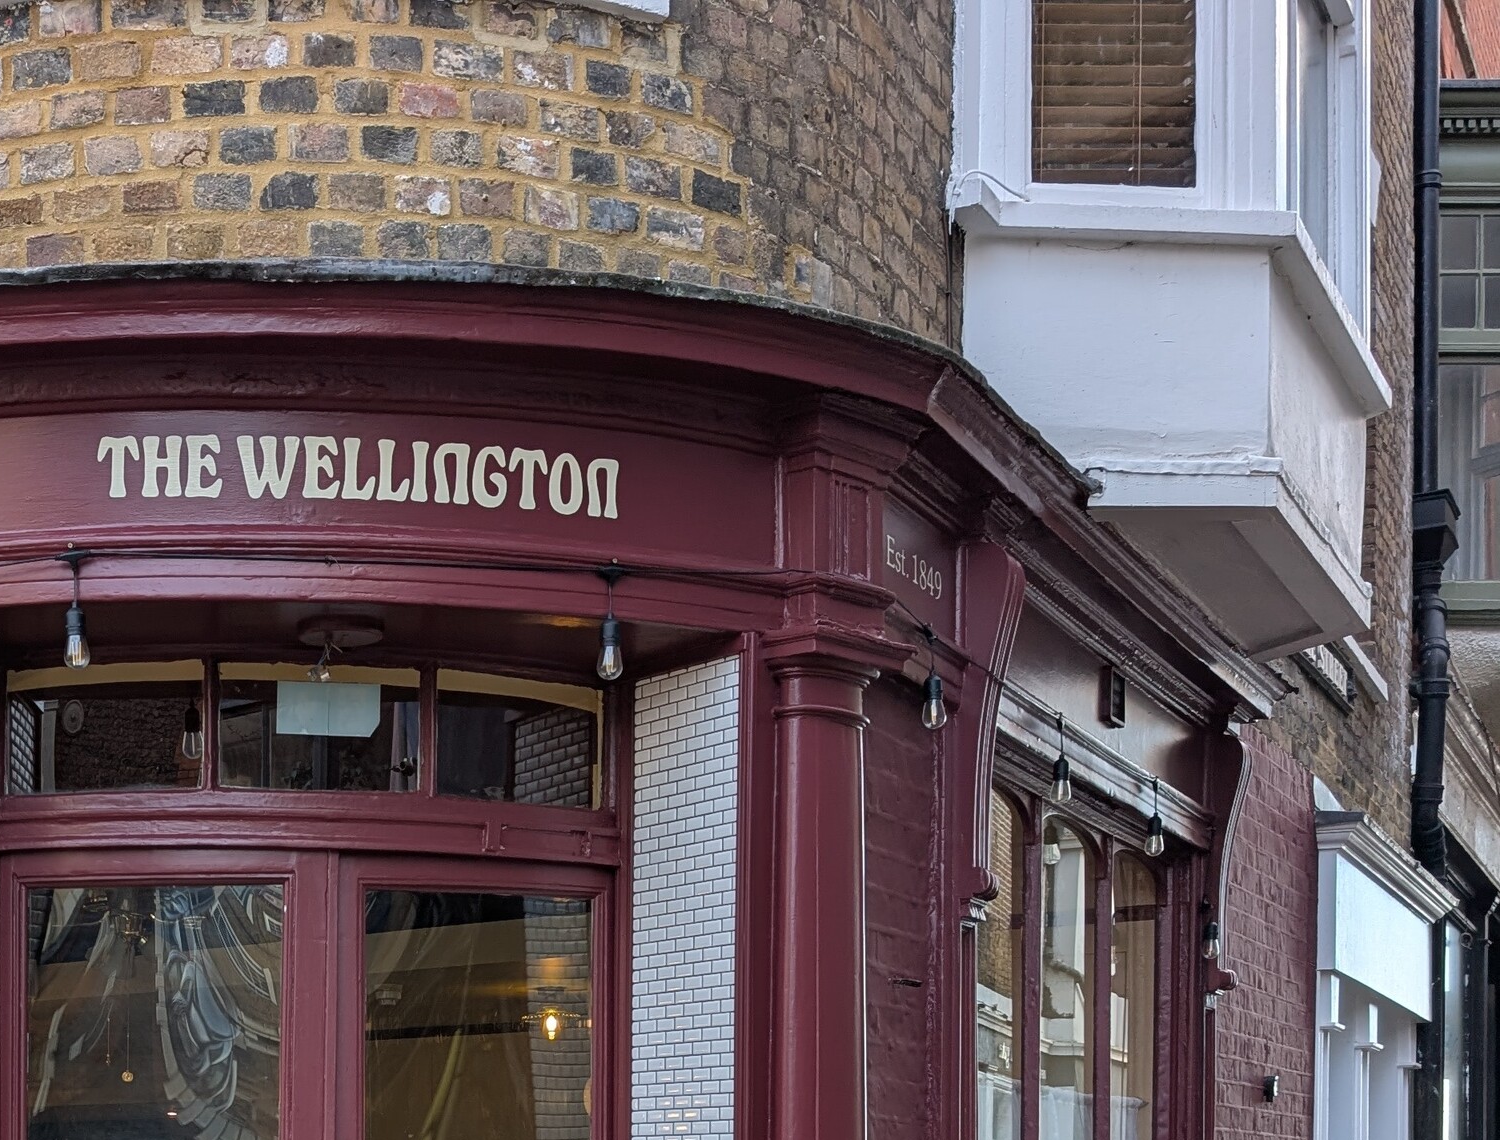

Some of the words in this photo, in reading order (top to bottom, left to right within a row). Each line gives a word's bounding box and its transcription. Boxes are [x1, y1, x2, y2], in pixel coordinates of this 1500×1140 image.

[97, 434, 223, 499] THE
[237, 435, 619, 519] WELLINGTON
[886, 534, 909, 578] Est.
[912, 554, 942, 600] 1849
